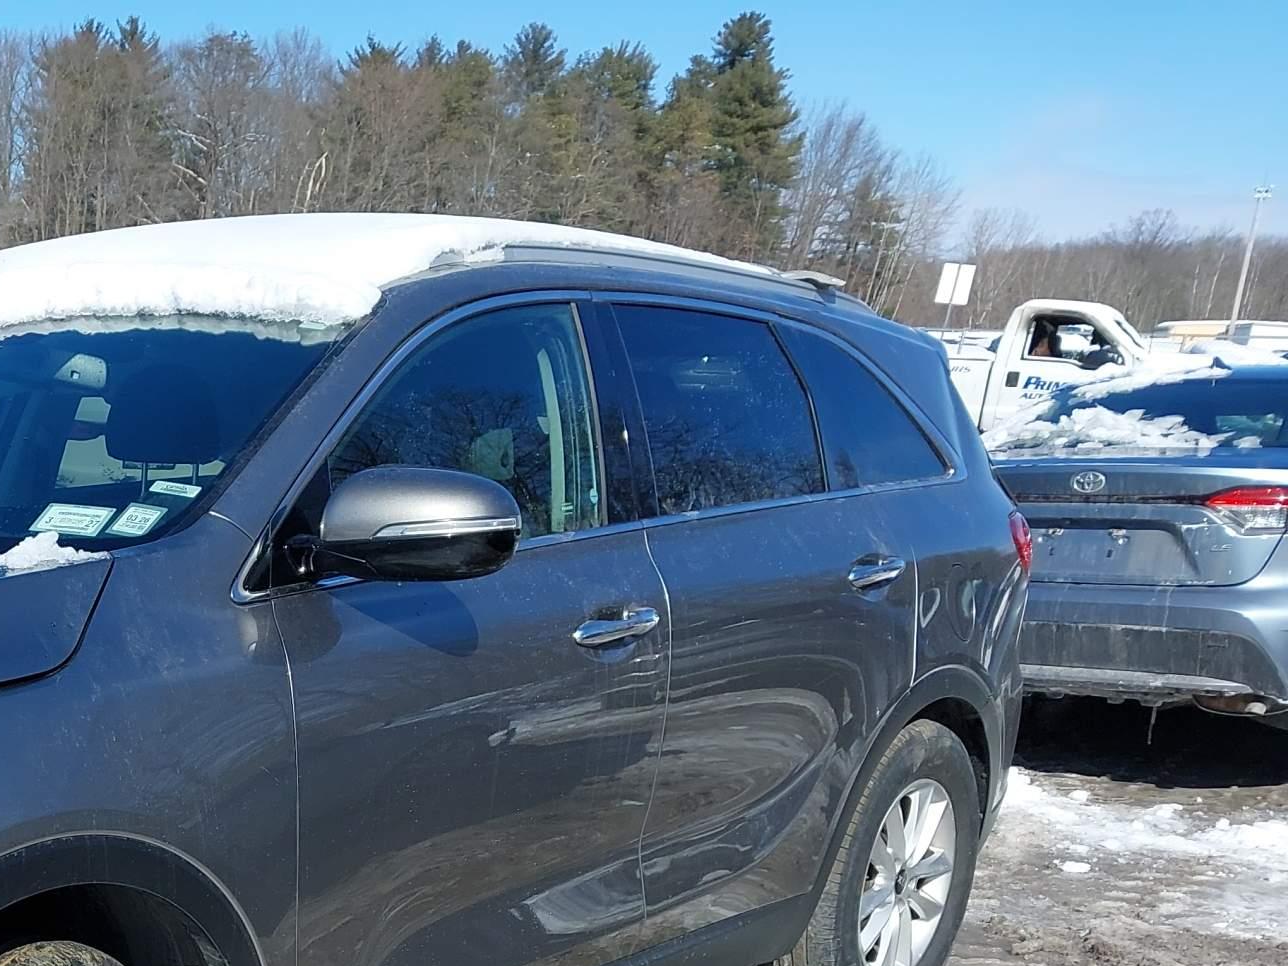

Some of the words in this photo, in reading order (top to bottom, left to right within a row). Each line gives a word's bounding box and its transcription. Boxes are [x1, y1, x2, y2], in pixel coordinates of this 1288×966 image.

[45, 516, 55, 524] 3
[126, 514, 139, 522] 03
[85, 520, 101, 528] 27
